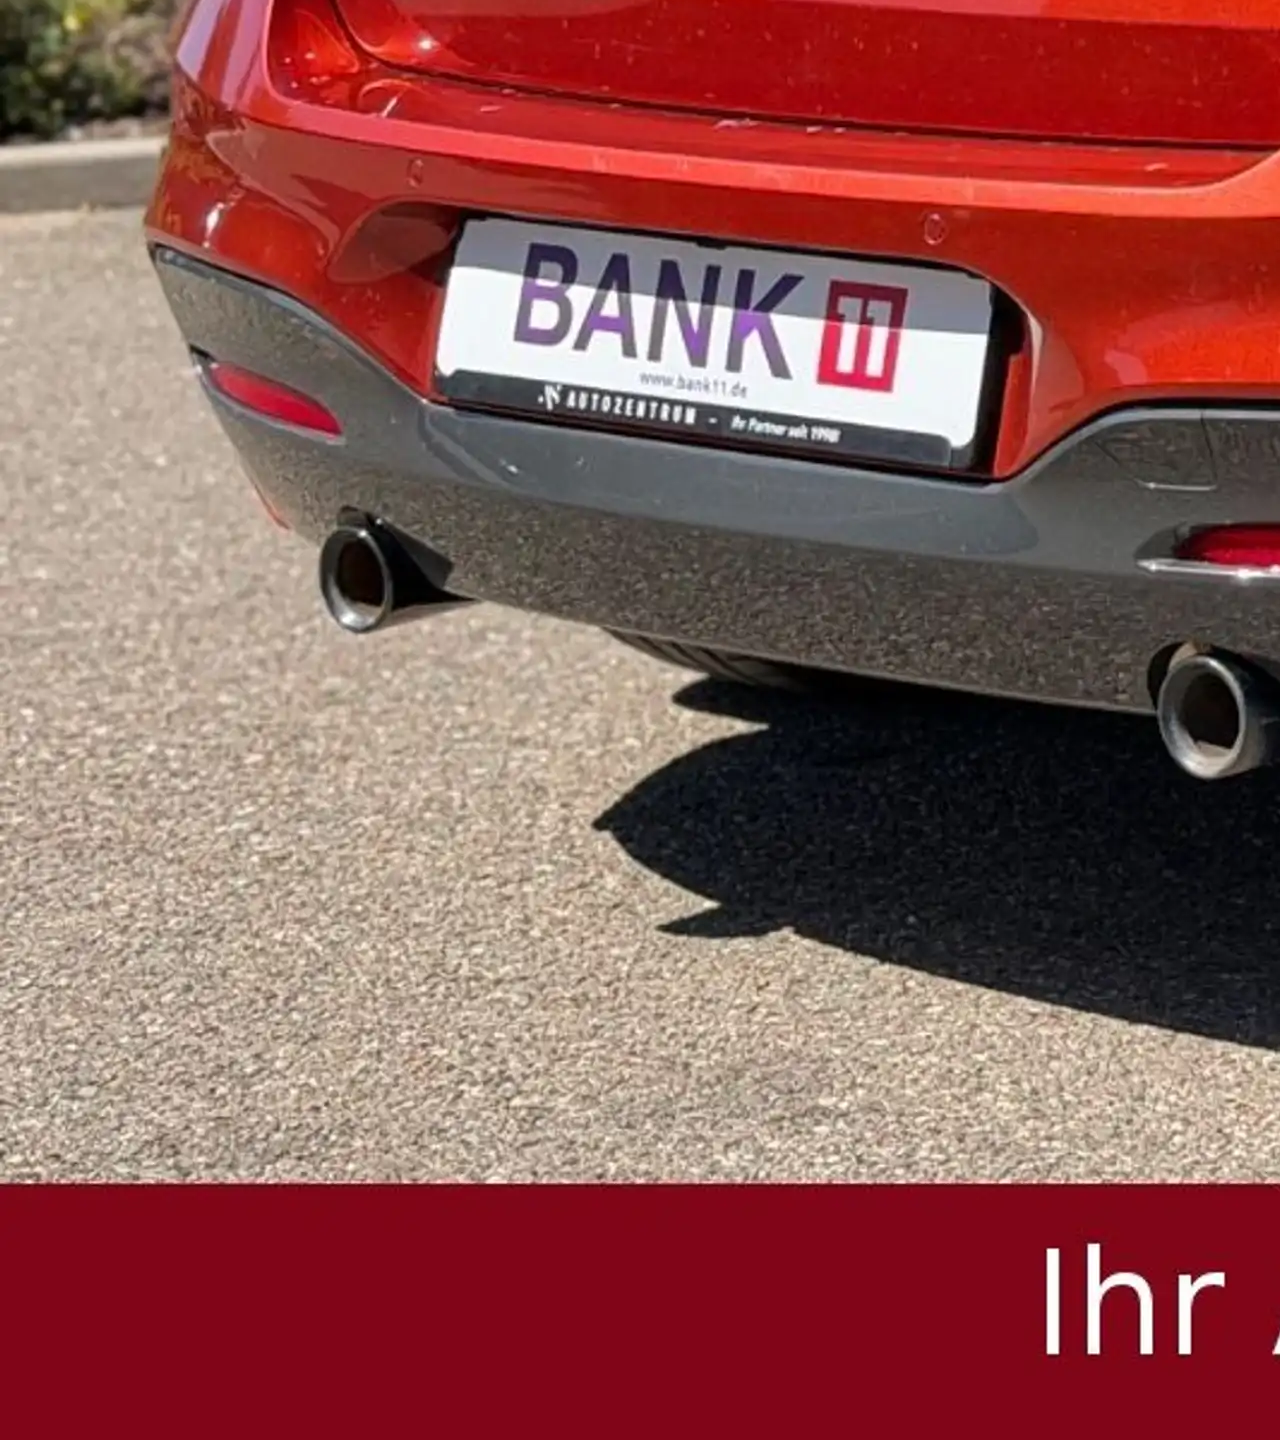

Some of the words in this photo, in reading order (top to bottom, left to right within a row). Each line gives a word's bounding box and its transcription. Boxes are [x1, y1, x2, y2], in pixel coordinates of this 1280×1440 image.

[513, 242, 804, 380] BANK
[834, 294, 893, 379] 11
[639, 370, 748, 400] www.bank11.de
[566, 389, 697, 426] AUTOZENTRUM
